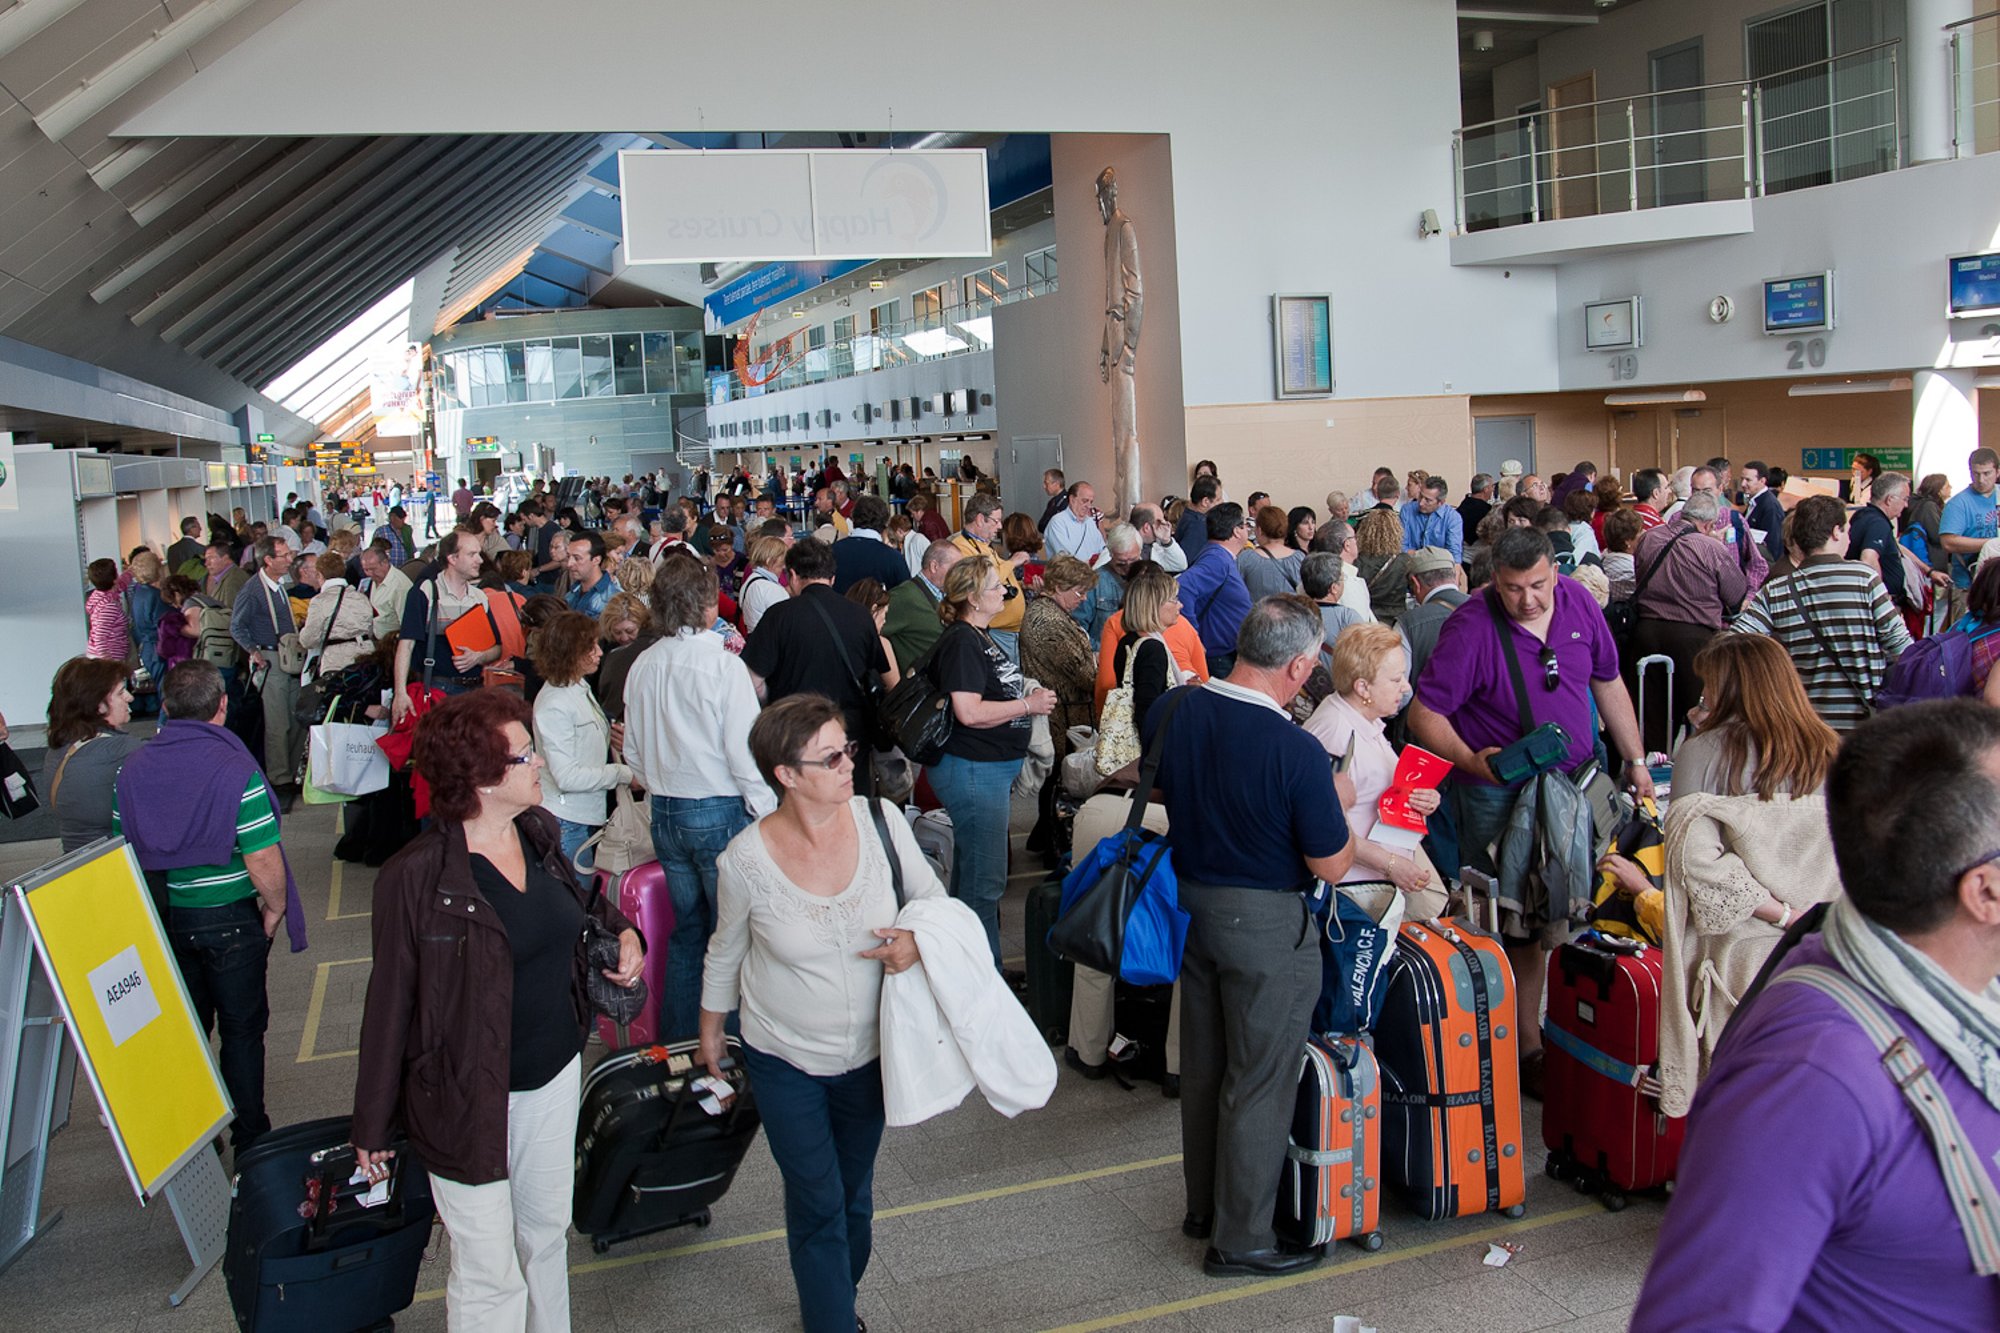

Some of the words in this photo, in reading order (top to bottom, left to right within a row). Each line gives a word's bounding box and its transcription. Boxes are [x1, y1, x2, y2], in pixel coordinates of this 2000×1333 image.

[1608, 354, 1638, 381] 19
[1786, 338, 1826, 369] 20
[345, 742, 376, 755] neuhaus
[106, 970, 142, 1005] AEA946
[1351, 949, 1373, 1007] VALENCIA
[1353, 1165, 1362, 1229] HAAON
